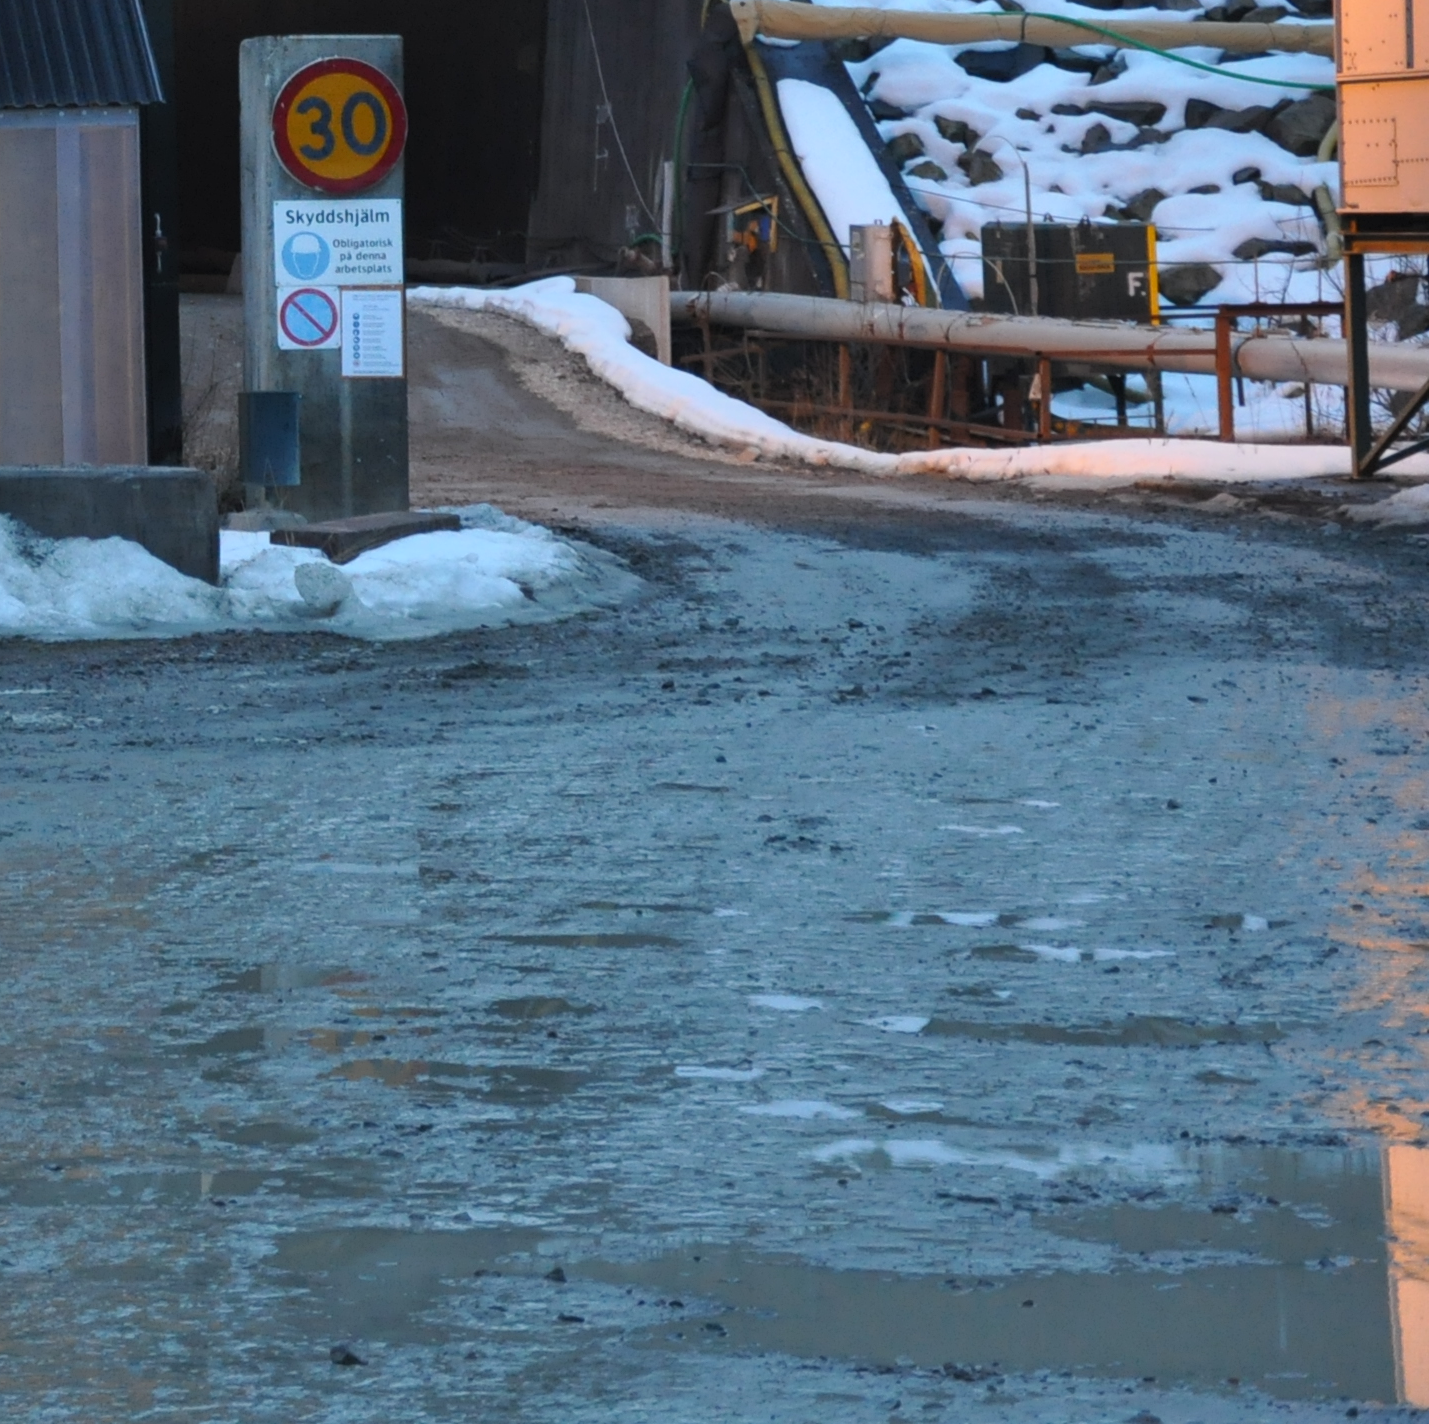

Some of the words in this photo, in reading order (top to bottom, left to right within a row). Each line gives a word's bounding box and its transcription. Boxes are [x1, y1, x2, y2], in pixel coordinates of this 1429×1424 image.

[296, 91, 387, 161] 30
[285, 208, 390, 227] Skyddshjälm
[333, 238, 393, 250] Obligatorisk
[339, 252, 352, 262] på
[356, 252, 387, 260] denna
[335, 264, 392, 274] arbetsplats
